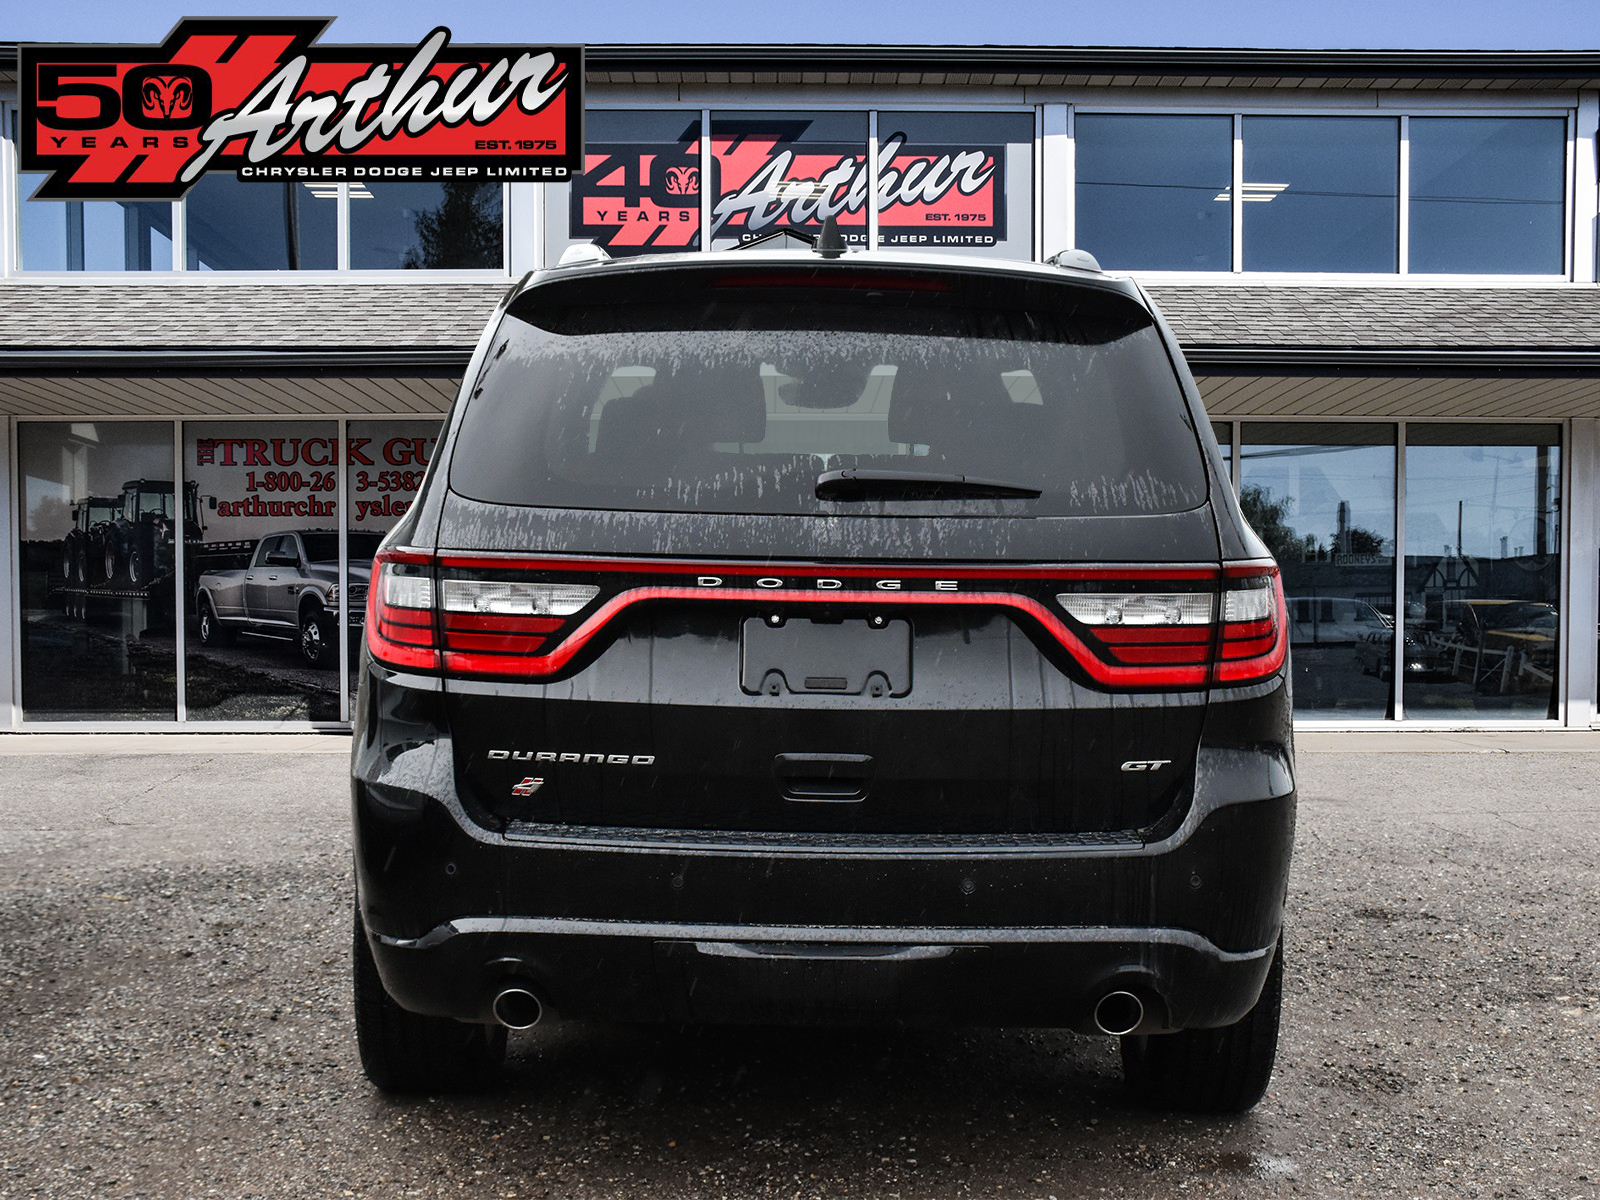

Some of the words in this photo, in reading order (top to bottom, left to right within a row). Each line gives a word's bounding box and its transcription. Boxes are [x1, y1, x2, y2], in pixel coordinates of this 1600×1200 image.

[583, 152, 722, 208] 40
[692, 141, 996, 247] Arthur
[597, 210, 690, 222] YEARS
[925, 213, 950, 221] EST.
[954, 213, 987, 221] 1975
[890, 234, 928, 243] JEEP
[933, 235, 995, 244] LIMITED
[197, 438, 215, 466] THE
[213, 437, 375, 467] TRUCK
[697, 576, 959, 591] DODGE
[487, 749, 656, 765] DURANGO
[1120, 759, 1172, 772] GT
